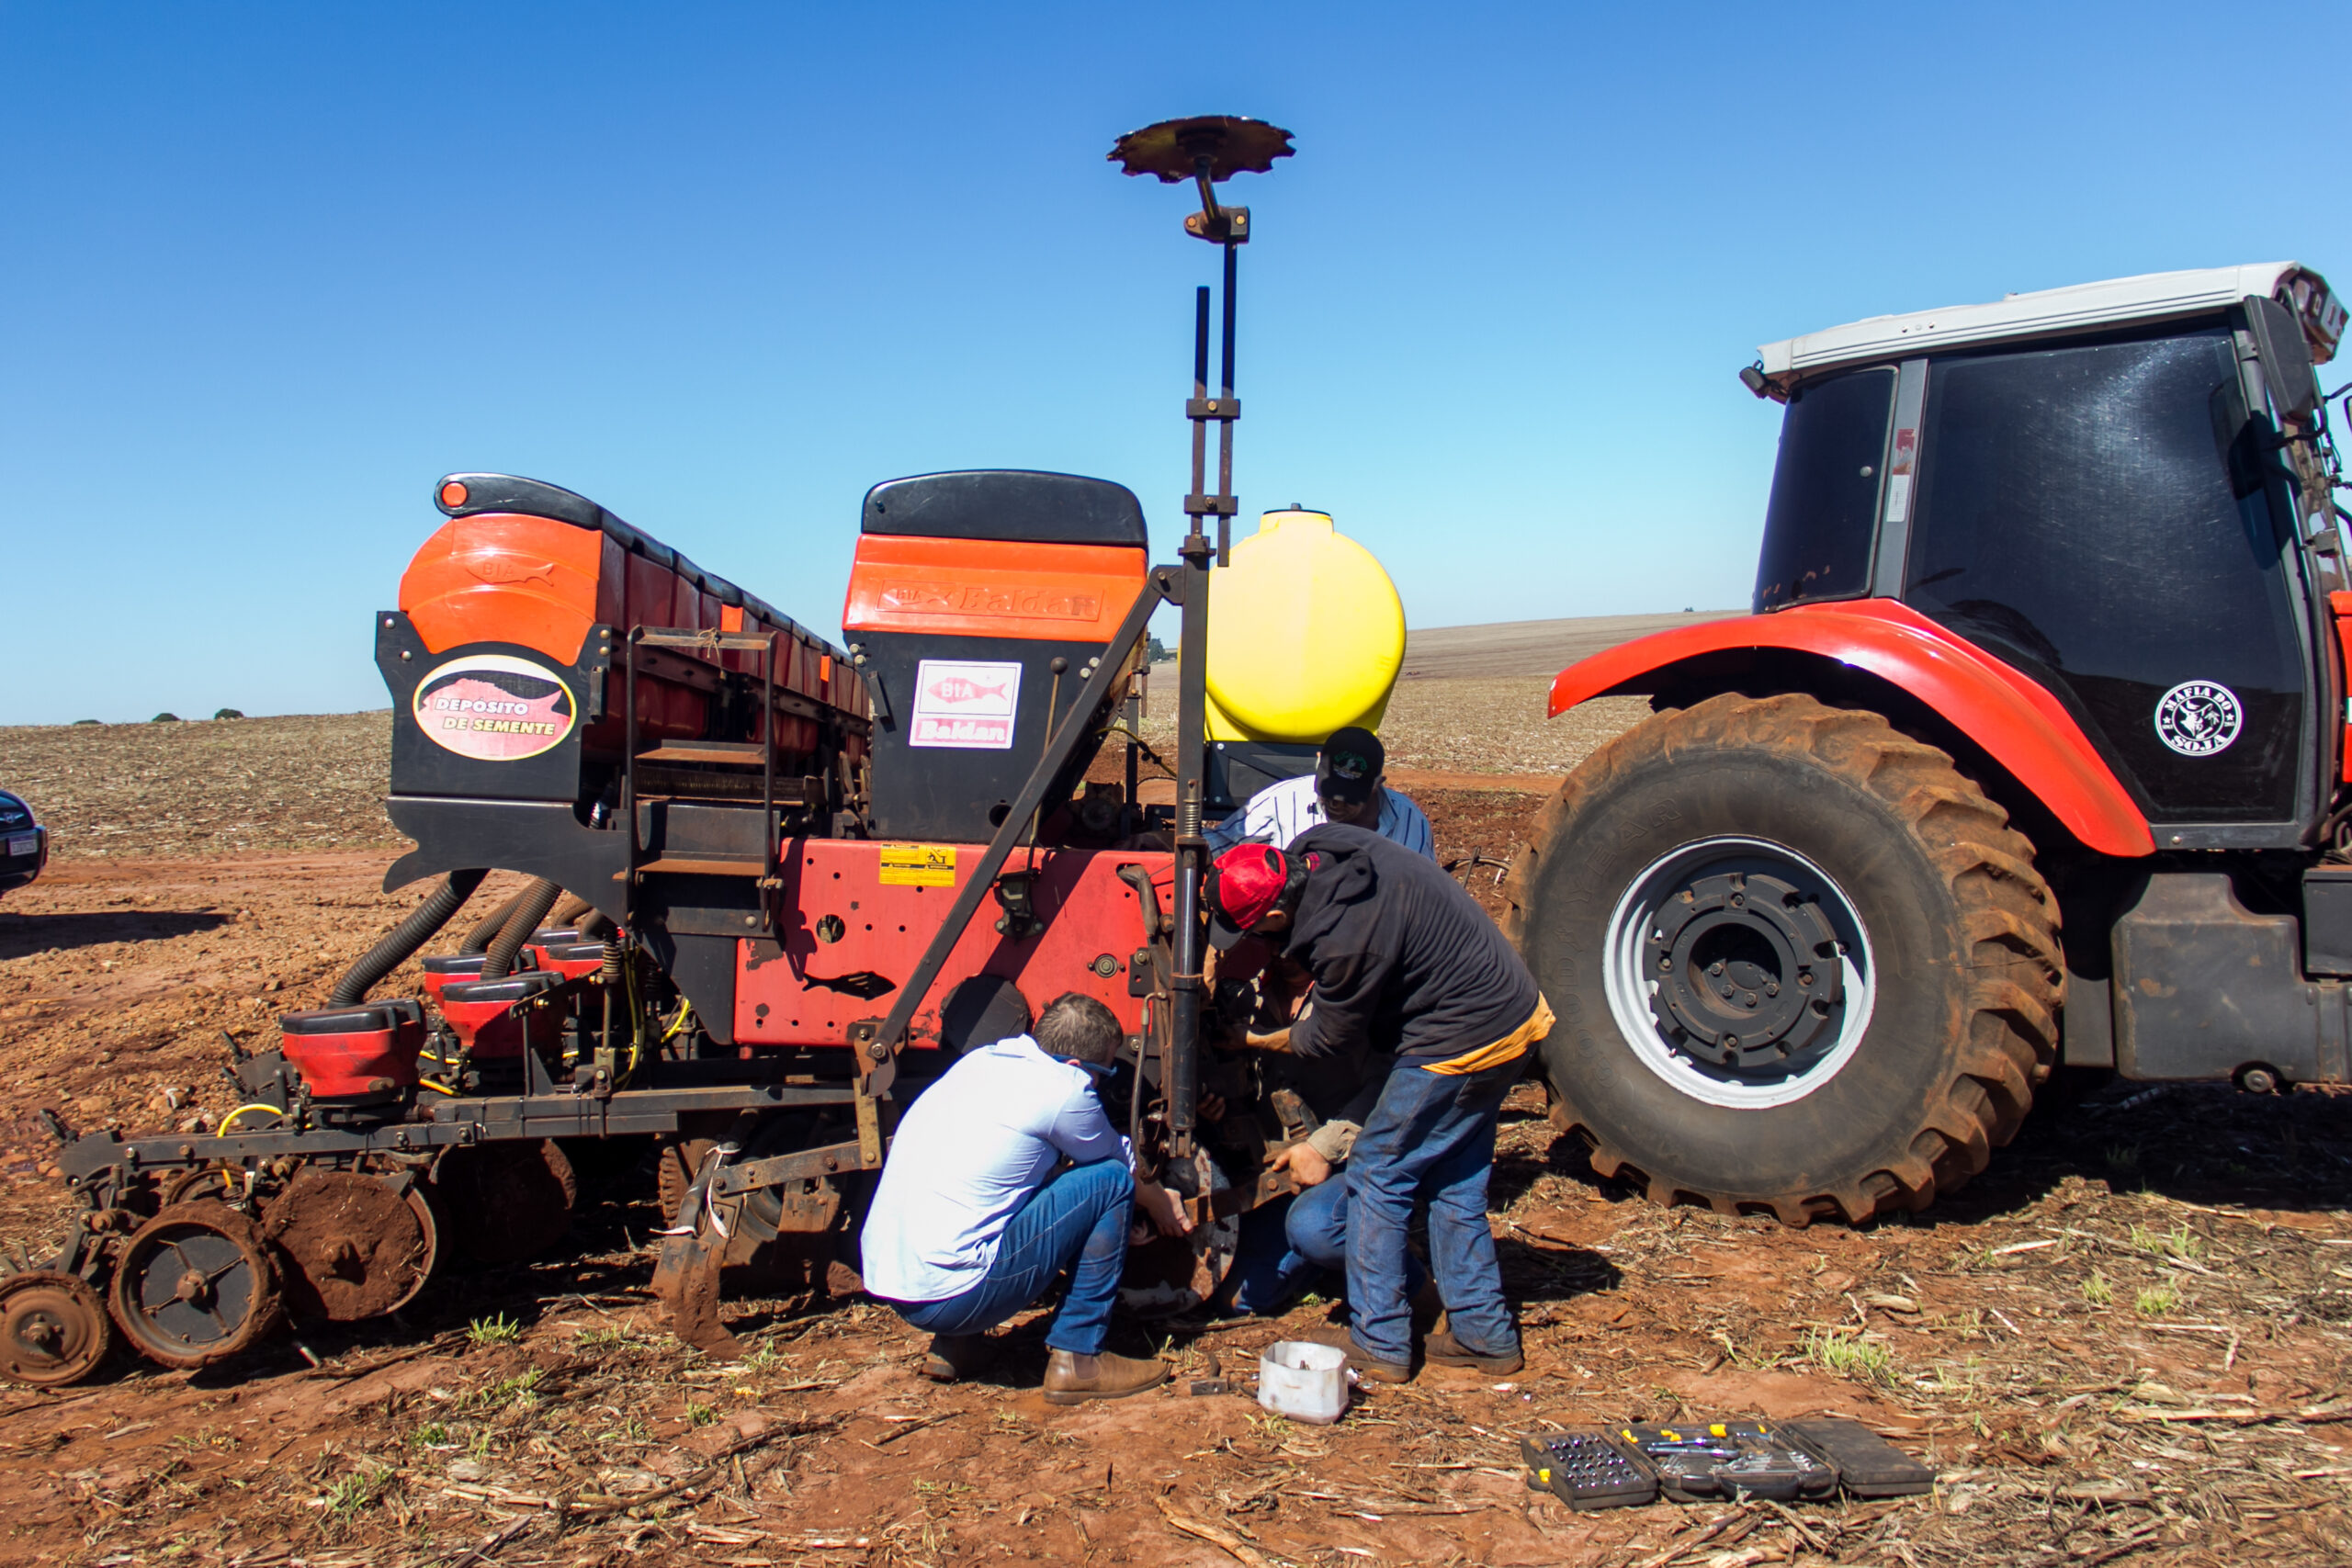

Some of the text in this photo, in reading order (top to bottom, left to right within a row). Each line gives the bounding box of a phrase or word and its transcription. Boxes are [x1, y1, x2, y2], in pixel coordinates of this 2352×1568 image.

[482, 562, 514, 577] BIA
[941, 682, 973, 698] BIA
[2164, 686, 2233, 711] MAFIA DO
[435, 696, 529, 716] DEPÓSITO
[443, 716, 556, 736] DE SEMENTE
[2171, 734, 2229, 751] SOJA
